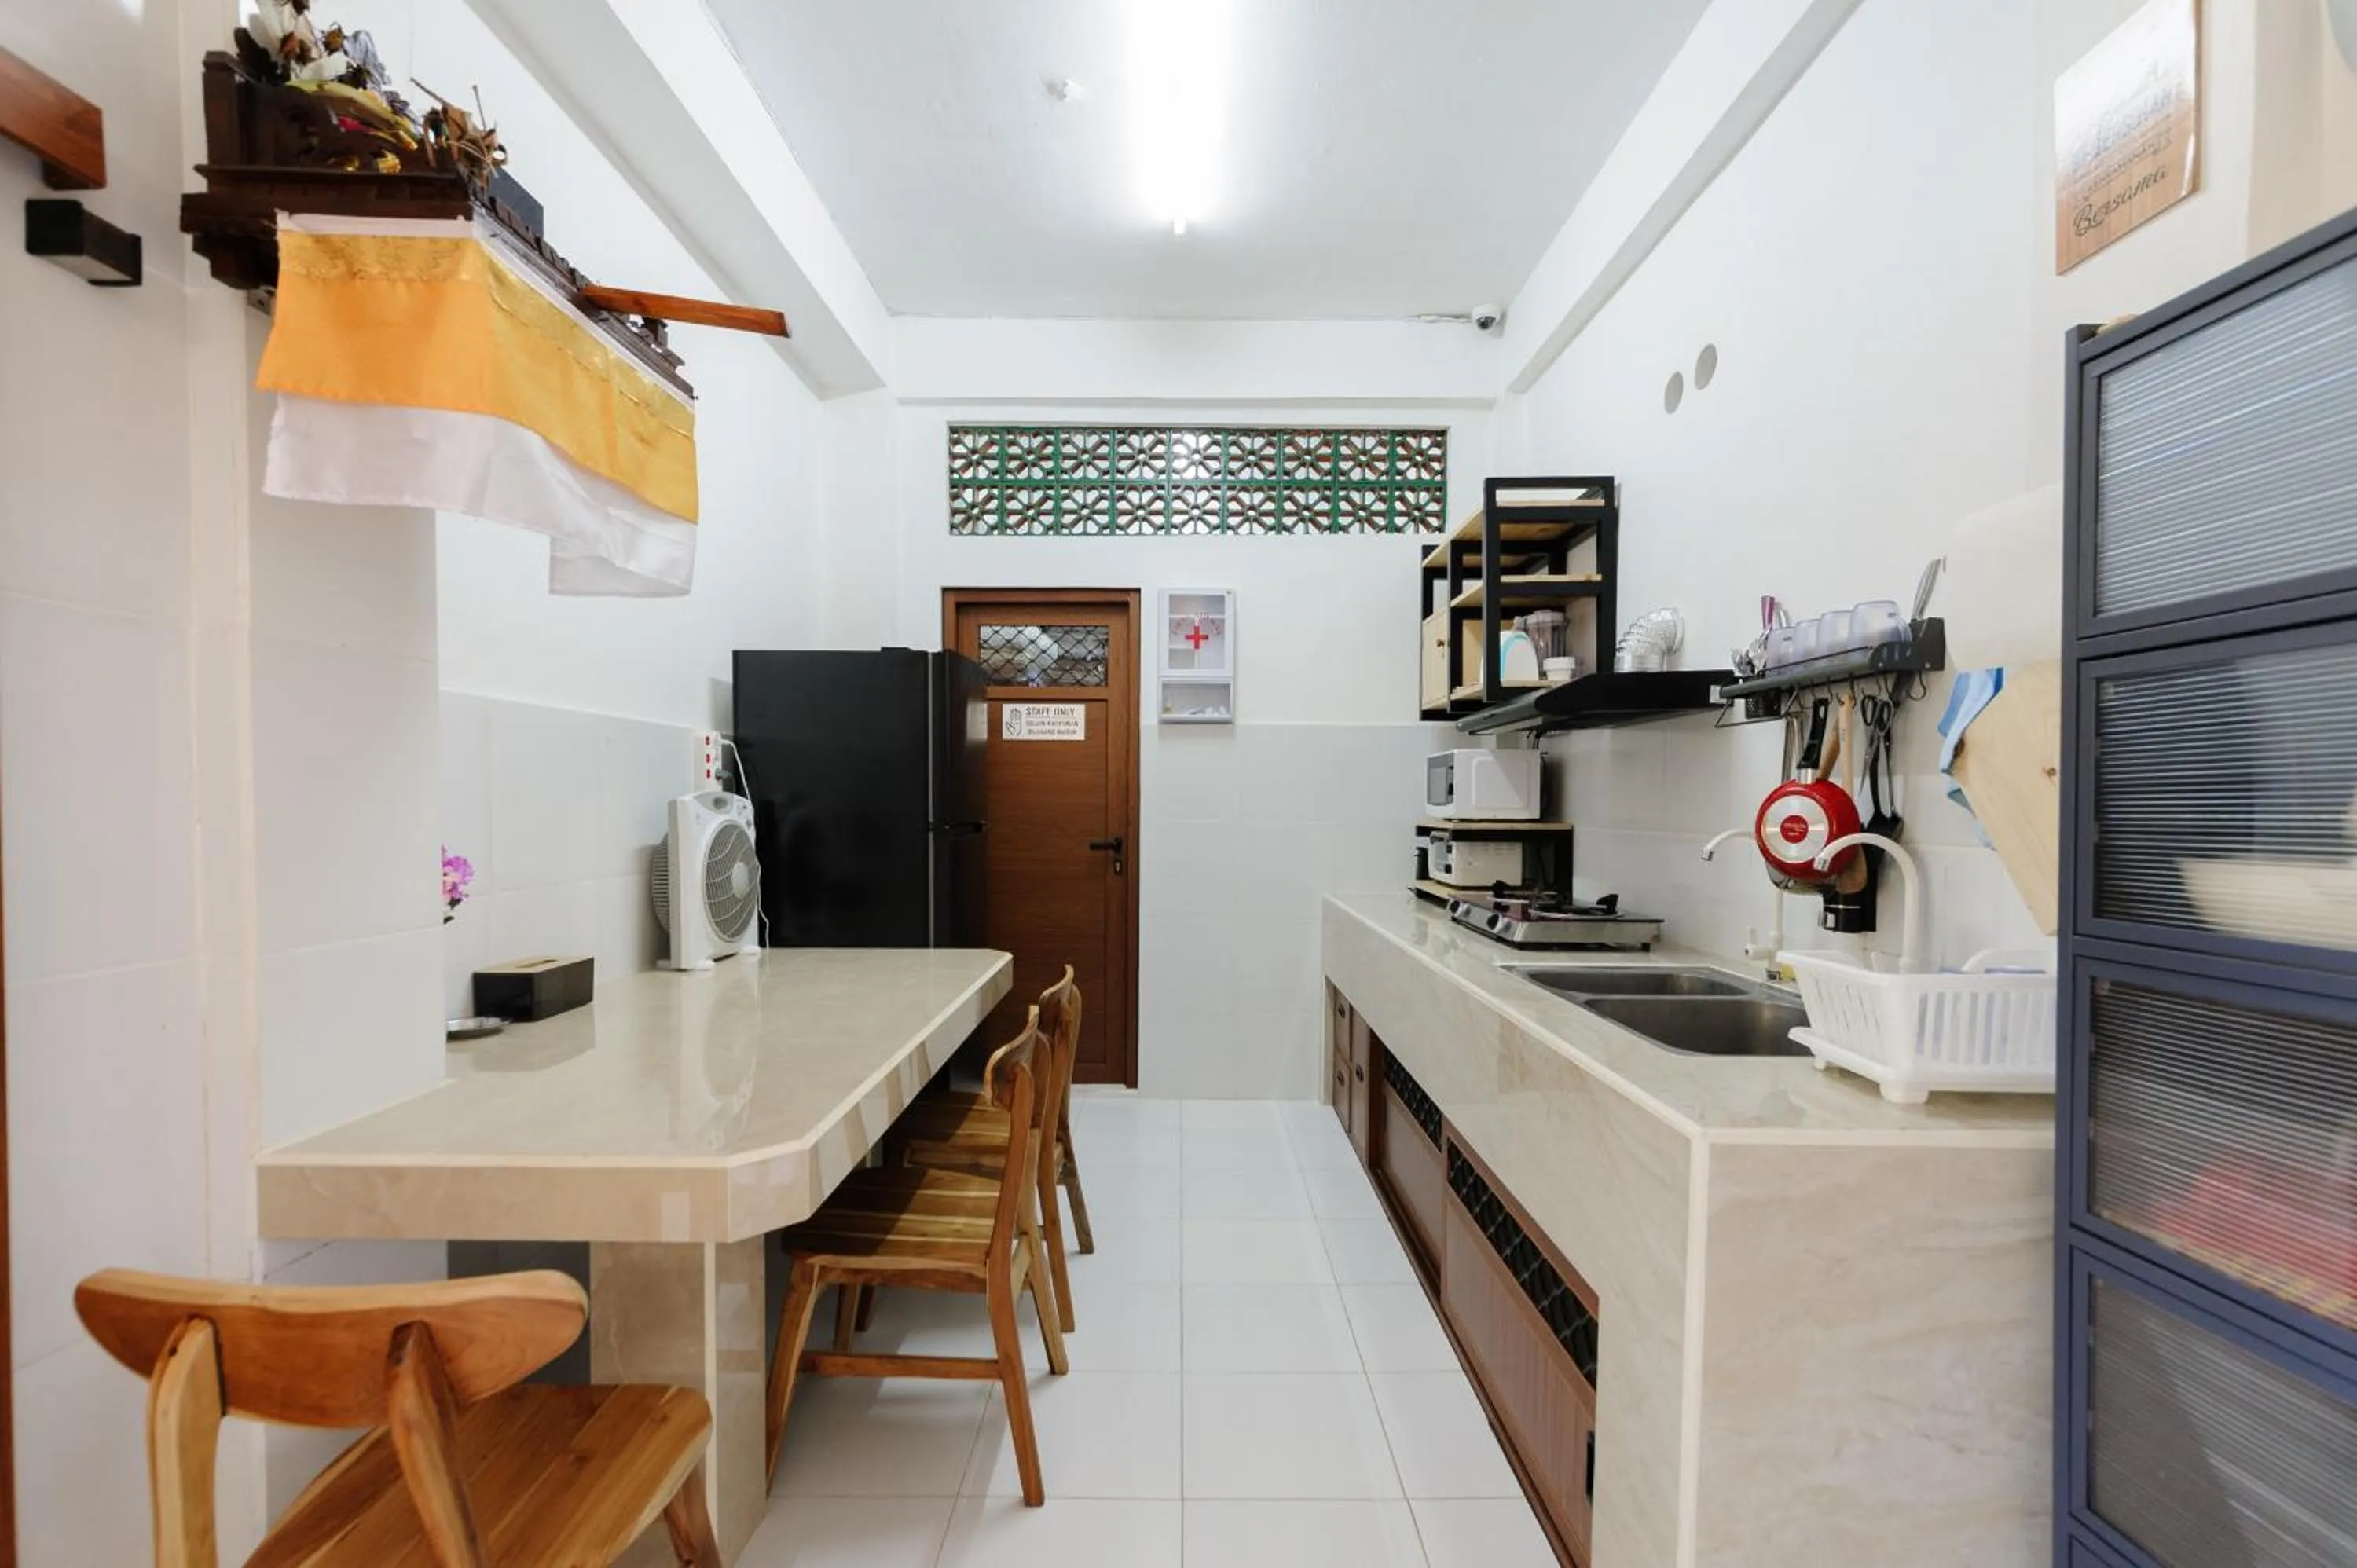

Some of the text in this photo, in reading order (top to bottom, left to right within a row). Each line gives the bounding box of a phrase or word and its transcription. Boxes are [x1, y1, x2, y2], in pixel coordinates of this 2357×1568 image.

[2074, 163, 2168, 237] Bersama
[1025, 706, 1076, 716] STAFF ONLY
